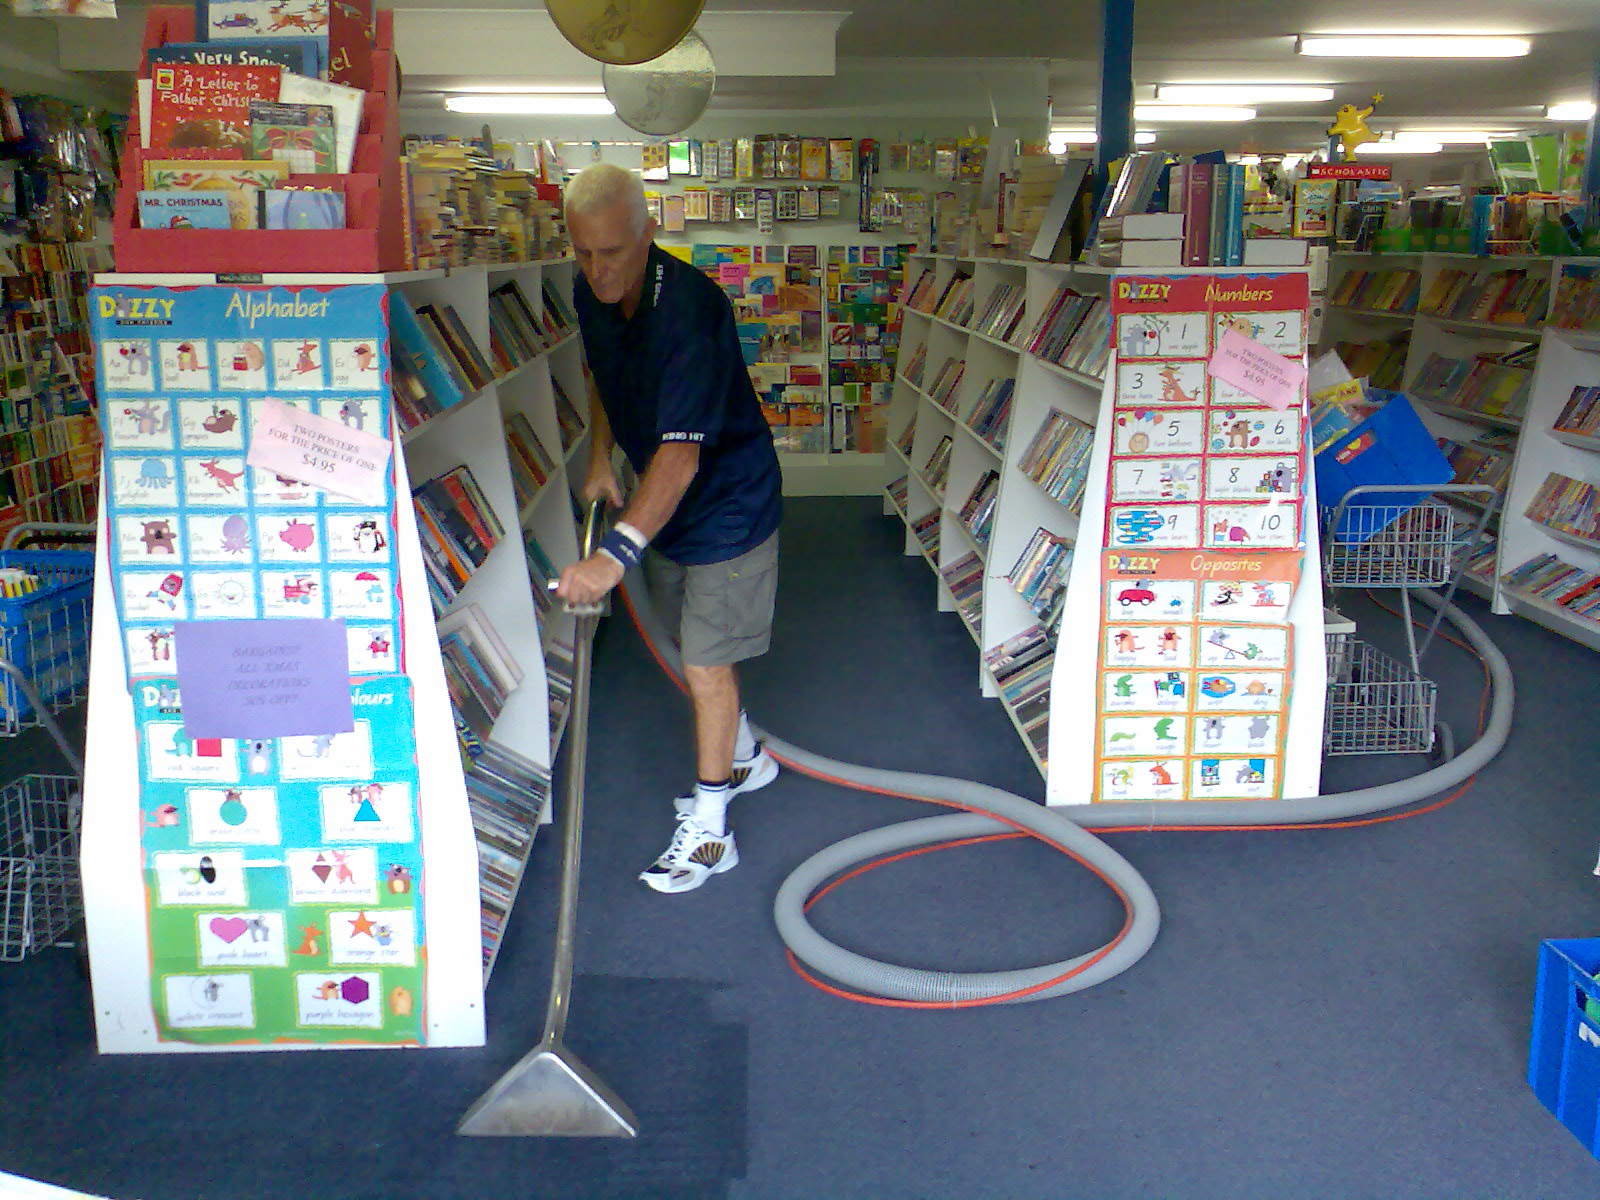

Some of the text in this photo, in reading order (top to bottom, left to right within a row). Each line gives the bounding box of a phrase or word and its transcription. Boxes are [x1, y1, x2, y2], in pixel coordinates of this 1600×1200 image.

[182, 75, 259, 91] A Letter to
[161, 92, 206, 106] Father
[1321, 168, 1389, 176] SCHOLASTIC
[166, 197, 224, 207] CHRISTMAS
[1204, 284, 1273, 302] Numbers
[224, 292, 330, 329] Alphabet
[1274, 321, 1287, 338] 2
[1131, 373, 1144, 390] 3
[1167, 420, 1181, 437] 5
[1274, 419, 1284, 436] 6
[294, 425, 360, 453] TWO POSTERS
[268, 428, 288, 440] FOR
[291, 436, 309, 449] THE
[311, 442, 338, 458] PRICE
[356, 459, 377, 472] ONE
[302, 453, 336, 473] $4.95
[1133, 469, 1144, 485] 7
[1229, 467, 1240, 483] 8
[1167, 515, 1178, 531] 9
[1261, 514, 1281, 531] 10
[1190, 554, 1263, 577] Opposites
[351, 688, 393, 705] lours
